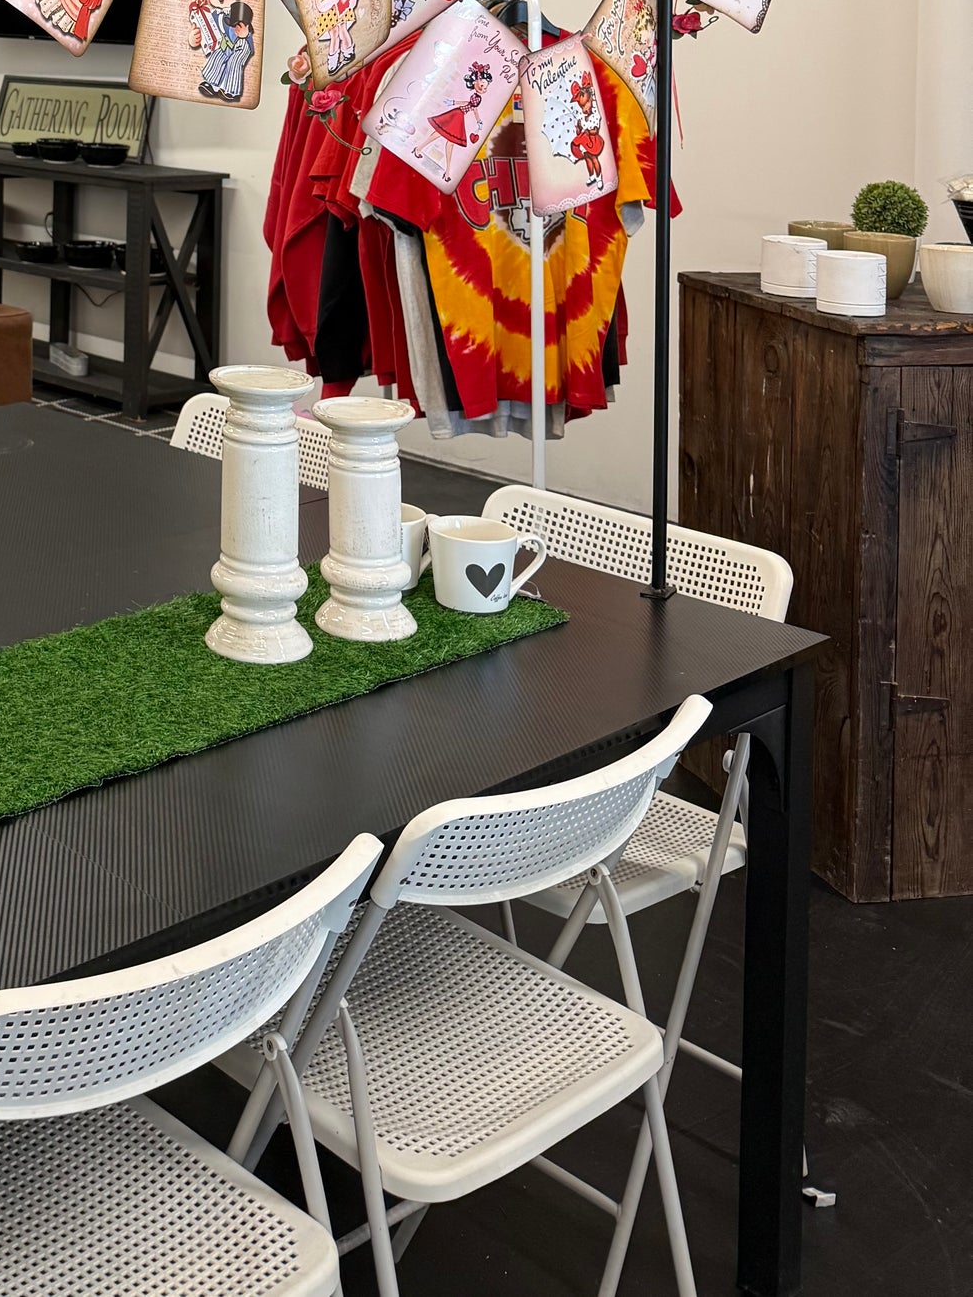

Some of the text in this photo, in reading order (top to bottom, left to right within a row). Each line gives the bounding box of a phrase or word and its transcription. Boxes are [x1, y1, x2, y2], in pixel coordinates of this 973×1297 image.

[467, 25, 489, 43] from
[483, 30, 506, 57] Your
[597, 14, 615, 55] For
[499, 64, 516, 84] Pal
[518, 54, 554, 85] To my
[531, 55, 578, 95] Valentine
[0, 88, 147, 144] GATHERING ROOM
